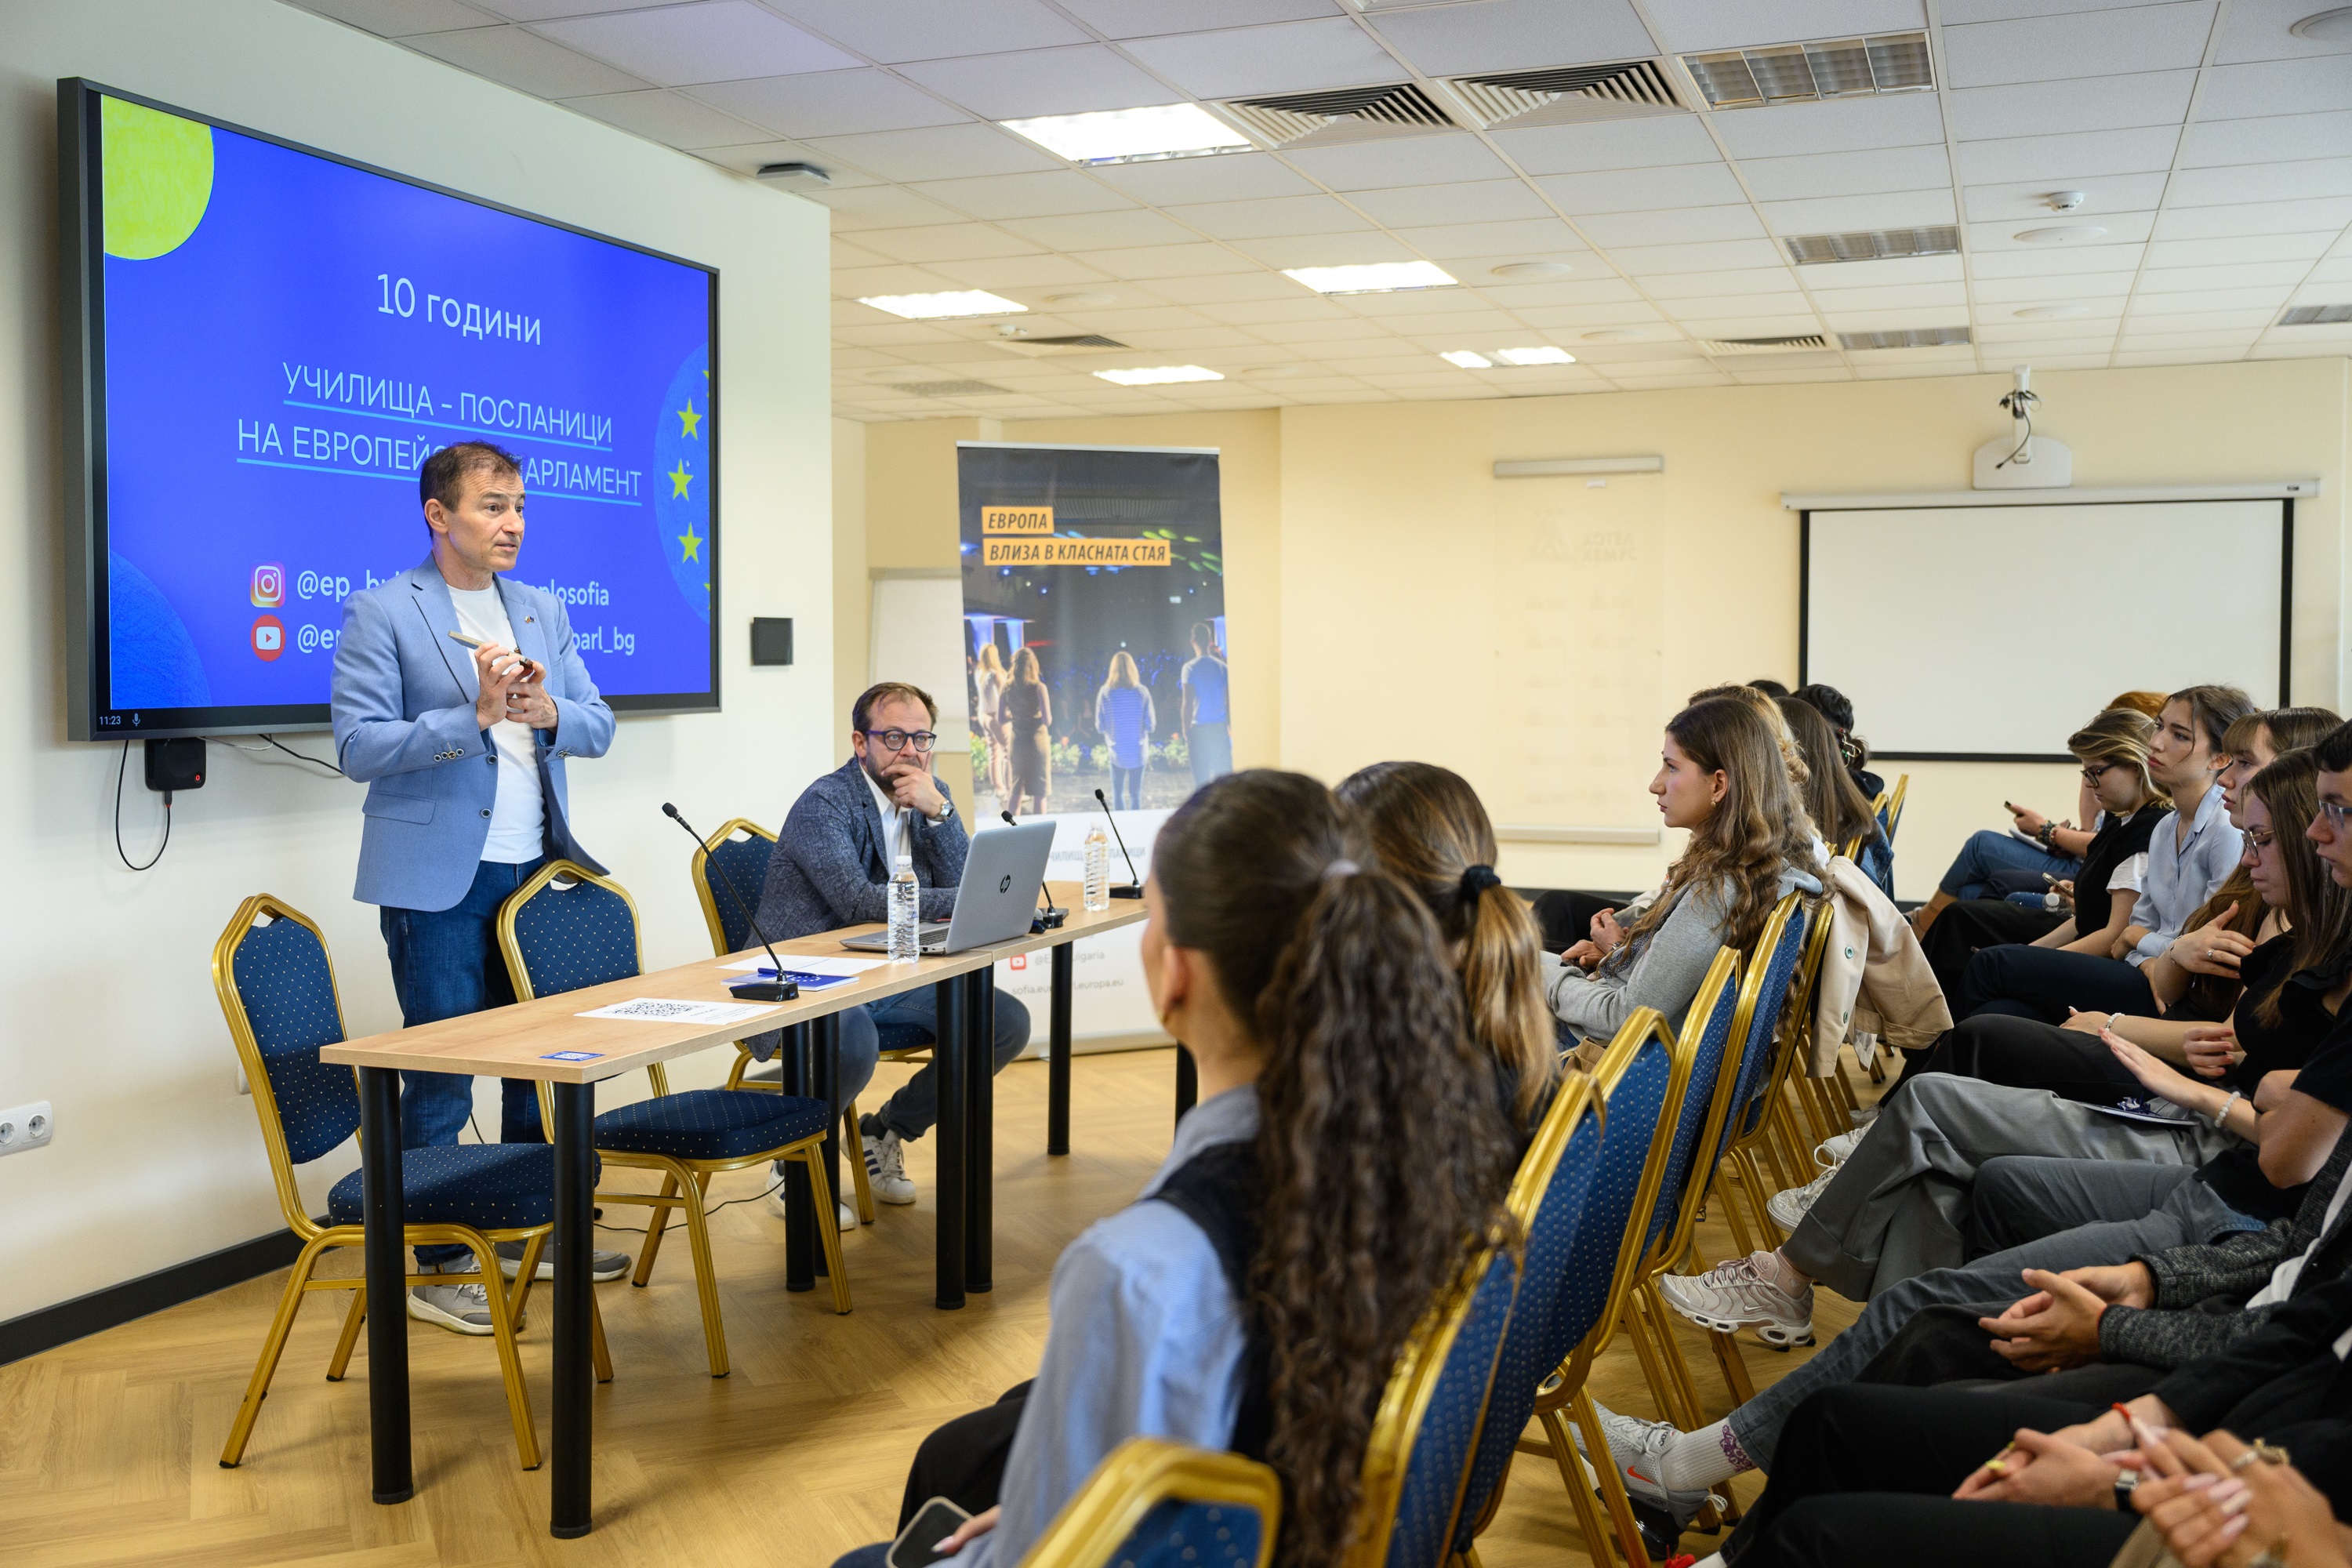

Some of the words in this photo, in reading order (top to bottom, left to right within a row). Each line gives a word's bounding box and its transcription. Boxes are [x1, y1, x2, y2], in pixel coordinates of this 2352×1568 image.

[377, 274, 416, 318] 10
[427, 294, 541, 345] години
[282, 361, 434, 418] УЧИЛИЩА
[460, 392, 612, 445] ПОСЛАНИЦИ
[238, 419, 284, 456] НА
[293, 426, 447, 470] ЕВРОПЕЙ
[510, 454, 642, 496] АРЛАМЕНТ
[988, 513, 1047, 529] ЕВРОПА
[989, 544, 1040, 561] ВЛИЗА
[1044, 545, 1054, 560] В
[1058, 545, 1129, 561] КЛАСНАТА
[1133, 546, 1166, 561] СТАЯ
[572, 626, 635, 656] parl_bg
[99, 715, 122, 725] 11:23
[1050, 850, 1084, 862] ЧИЛИЩ
